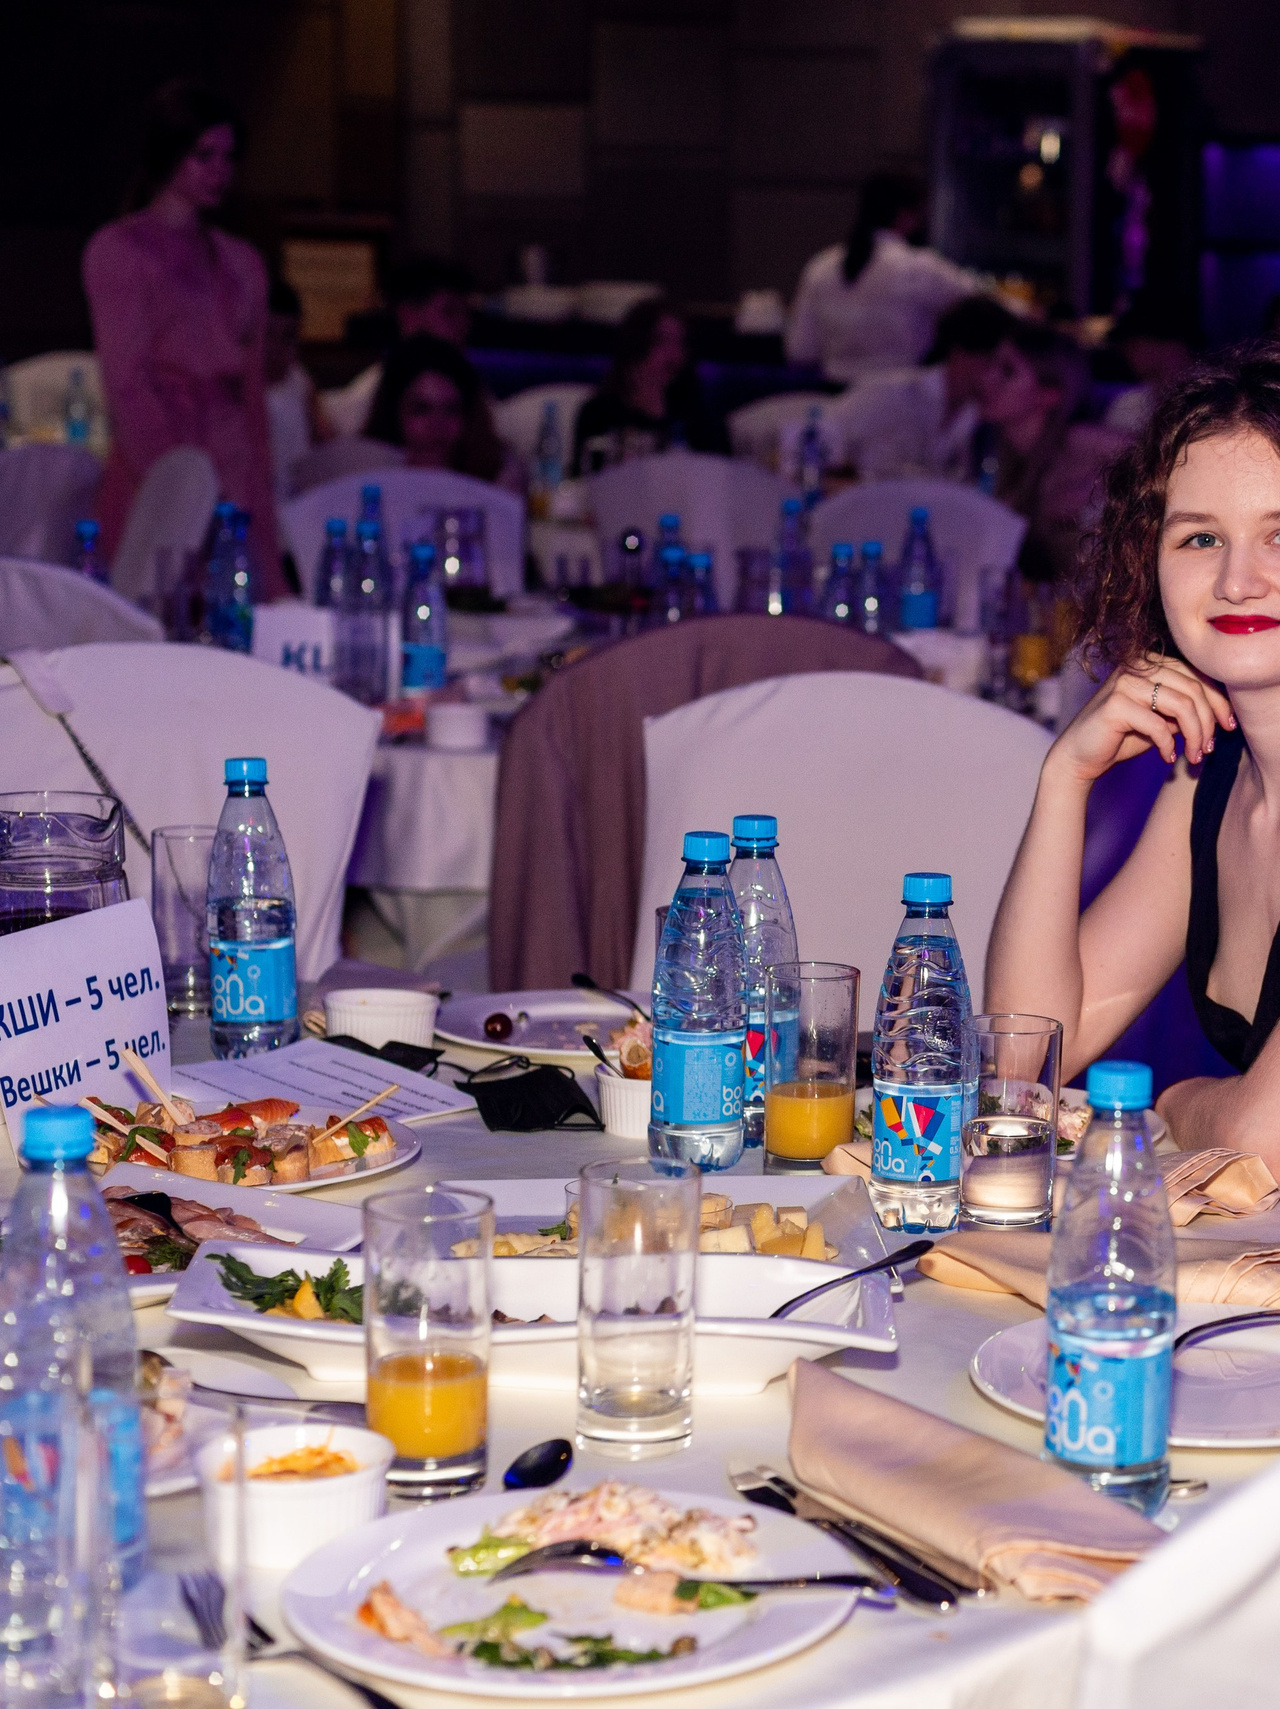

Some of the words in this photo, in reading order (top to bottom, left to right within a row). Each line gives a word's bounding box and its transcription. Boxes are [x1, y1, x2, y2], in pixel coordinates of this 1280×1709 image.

[86, 975, 103, 1010] 5
[108, 967, 160, 1001] чел.
[214, 994, 265, 1018] qua
[0, 1059, 82, 1108] Вешки
[105, 1038, 120, 1070] 5
[722, 1099, 743, 1116] aq
[874, 1153, 905, 1173] qua
[1048, 1416, 1116, 1455] qua
